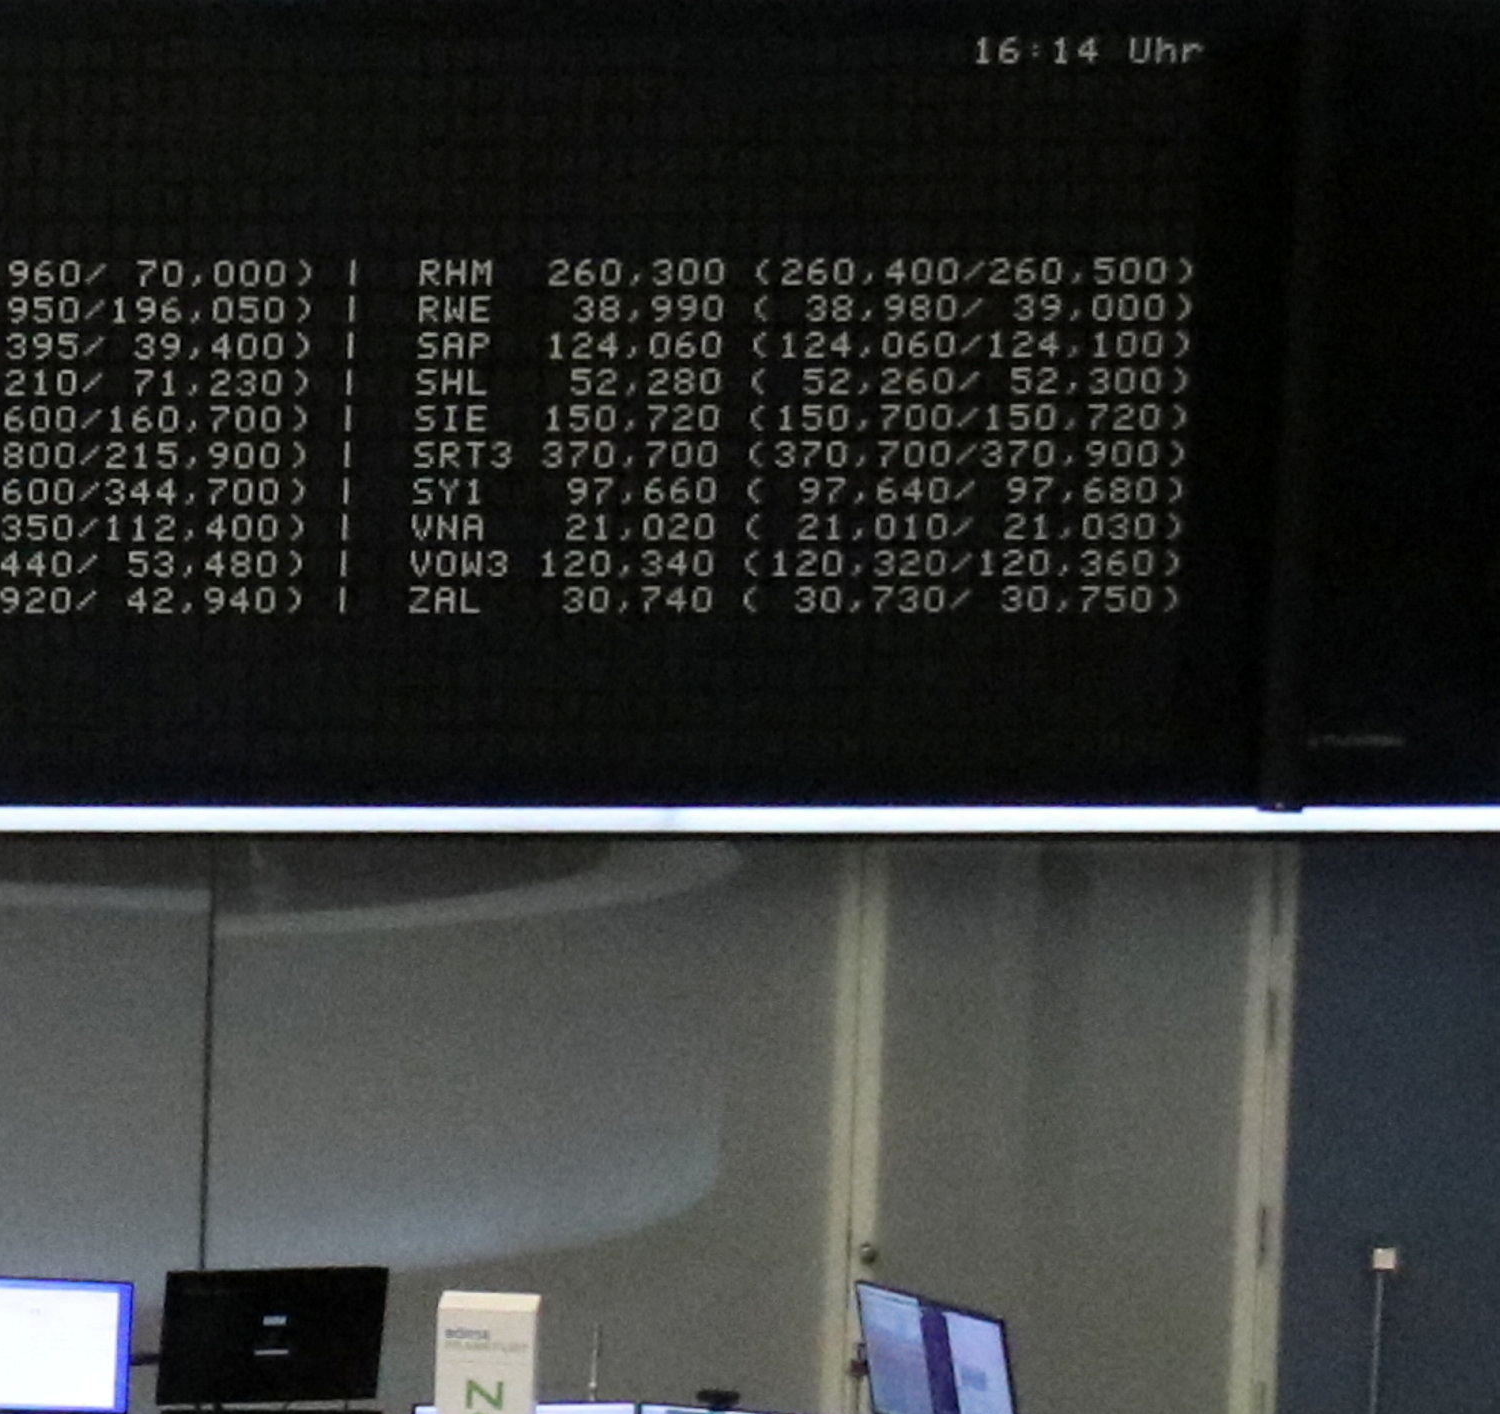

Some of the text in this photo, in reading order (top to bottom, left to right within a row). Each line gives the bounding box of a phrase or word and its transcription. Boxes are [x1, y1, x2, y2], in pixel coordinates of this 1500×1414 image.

[976, 36, 1202, 65] 16:14 Uhr
[418, 257, 725, 287] RHM 260,300
[418, 294, 724, 324] RWE 38,990
[417, 330, 723, 360] SAP 124,060
[416, 367, 721, 396] SHL 52,280
[415, 403, 720, 433] SIE 150,720
[414, 440, 718, 469] SRT3 370,700
[412, 476, 717, 506] SY1 97,660
[411, 512, 715, 542] VNA 21,020
[410, 549, 714, 578] VOW3 120,340
[409, 585, 713, 614] ZAL 30,740
